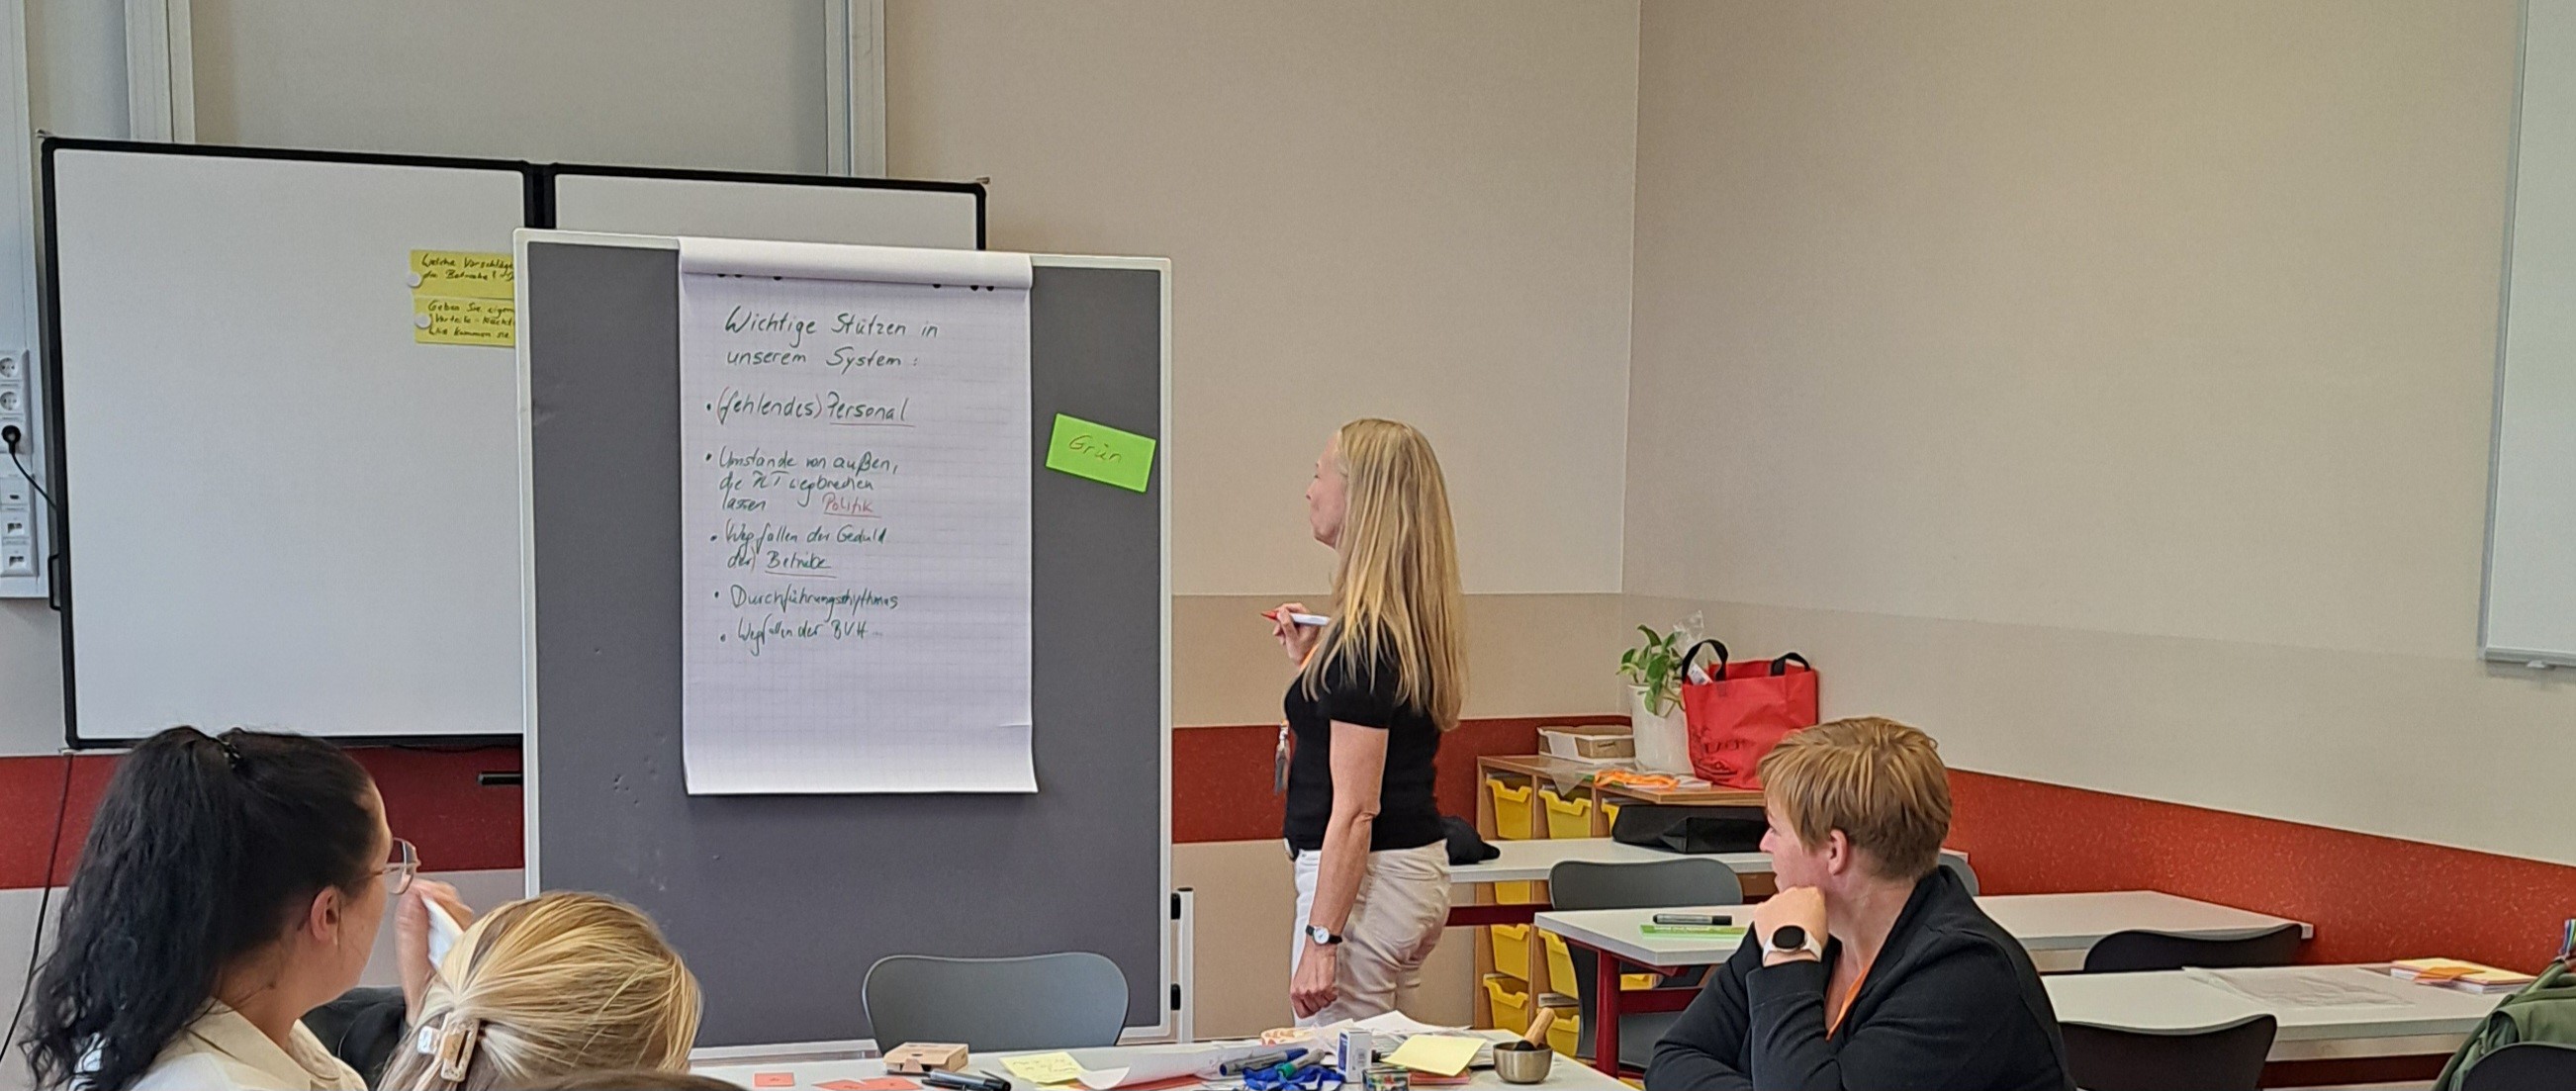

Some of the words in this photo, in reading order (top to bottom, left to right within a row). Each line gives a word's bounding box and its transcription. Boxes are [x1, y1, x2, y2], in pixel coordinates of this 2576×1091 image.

[724, 305, 818, 348] Wichtige
[830, 312, 906, 337] Stützen
[920, 320, 939, 338] in
[726, 349, 807, 366] unserem
[827, 390, 909, 423] Personal
[1067, 434, 1123, 464] Grün
[821, 491, 874, 514] Politik
[836, 523, 887, 545] Geduld
[766, 549, 832, 570] Betriebe
